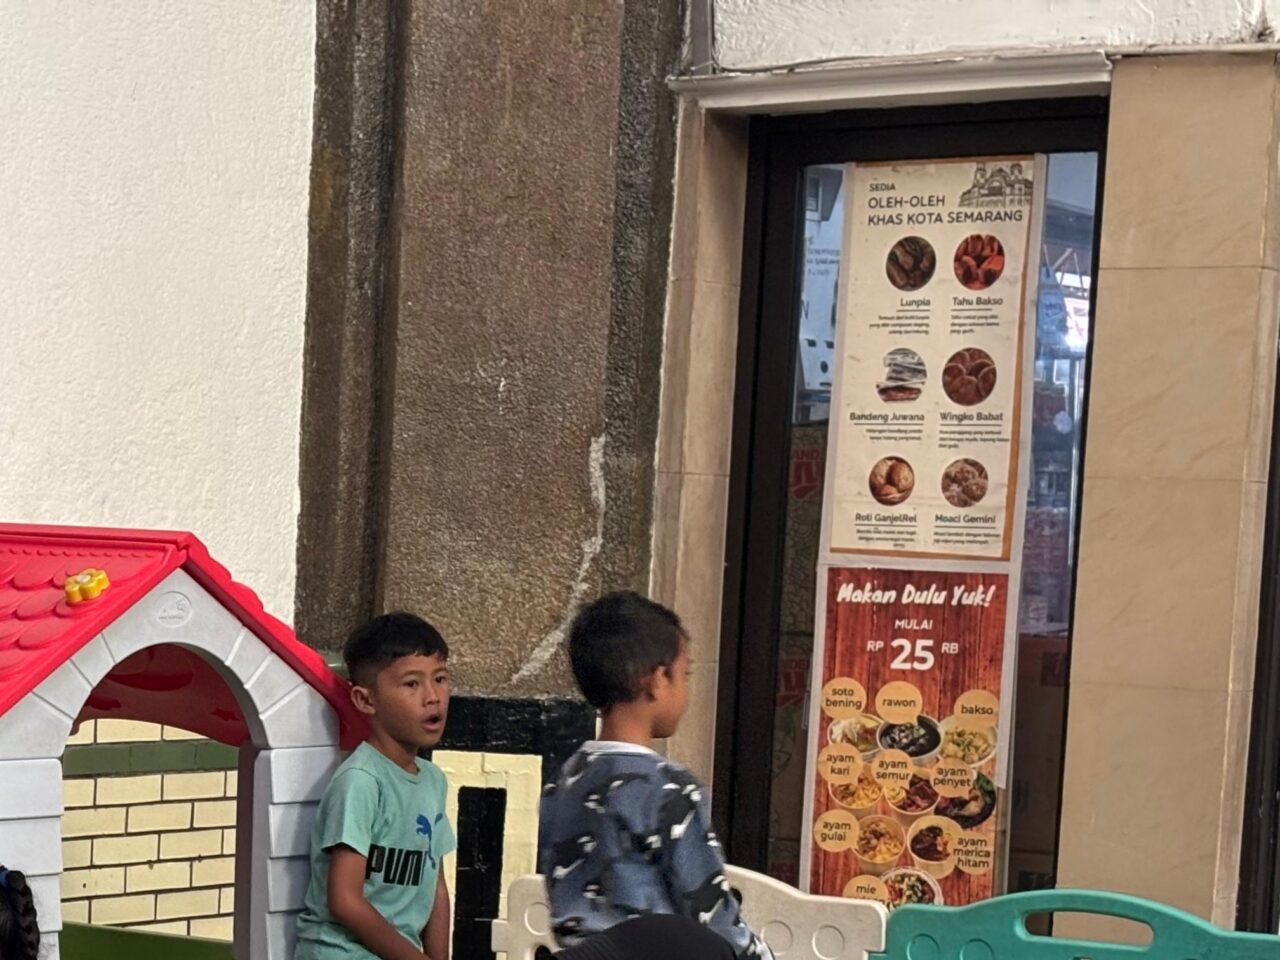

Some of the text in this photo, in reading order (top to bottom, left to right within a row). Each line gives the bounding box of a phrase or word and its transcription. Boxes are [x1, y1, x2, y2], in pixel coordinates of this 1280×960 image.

[869, 183, 896, 192] SEDIA
[868, 195, 945, 209] OLEH-OLEH
[868, 210, 1023, 226] KHAS KOTA SEMARANG
[900, 297, 931, 308] Lunpia
[952, 297, 1003, 306] Tahu Bakso
[849, 412, 925, 423] Bandeng Juwana
[939, 412, 1003, 423] Wingko Babat
[855, 513, 872, 522] Roti
[935, 514, 996, 524] Moaci Gemini
[836, 582, 996, 607] Makan Dulu Yuk!
[894, 619, 934, 630] MULAI
[866, 638, 959, 671] RP 25 RB
[831, 688, 854, 697] soto
[825, 698, 862, 710] bening
[882, 698, 916, 708] rawon
[961, 704, 994, 715] bakso
[826, 754, 855, 765] ayam
[830, 765, 850, 776] kari
[878, 760, 908, 771] ayam
[876, 771, 910, 781] semur
[937, 767, 968, 778] ayam
[933, 777, 972, 788] penyet
[822, 820, 851, 831] ayam
[820, 831, 847, 843] gulai
[957, 837, 988, 848] ayam
[953, 848, 991, 858] merica
[957, 858, 990, 869] hitam
[856, 883, 877, 894] mie
